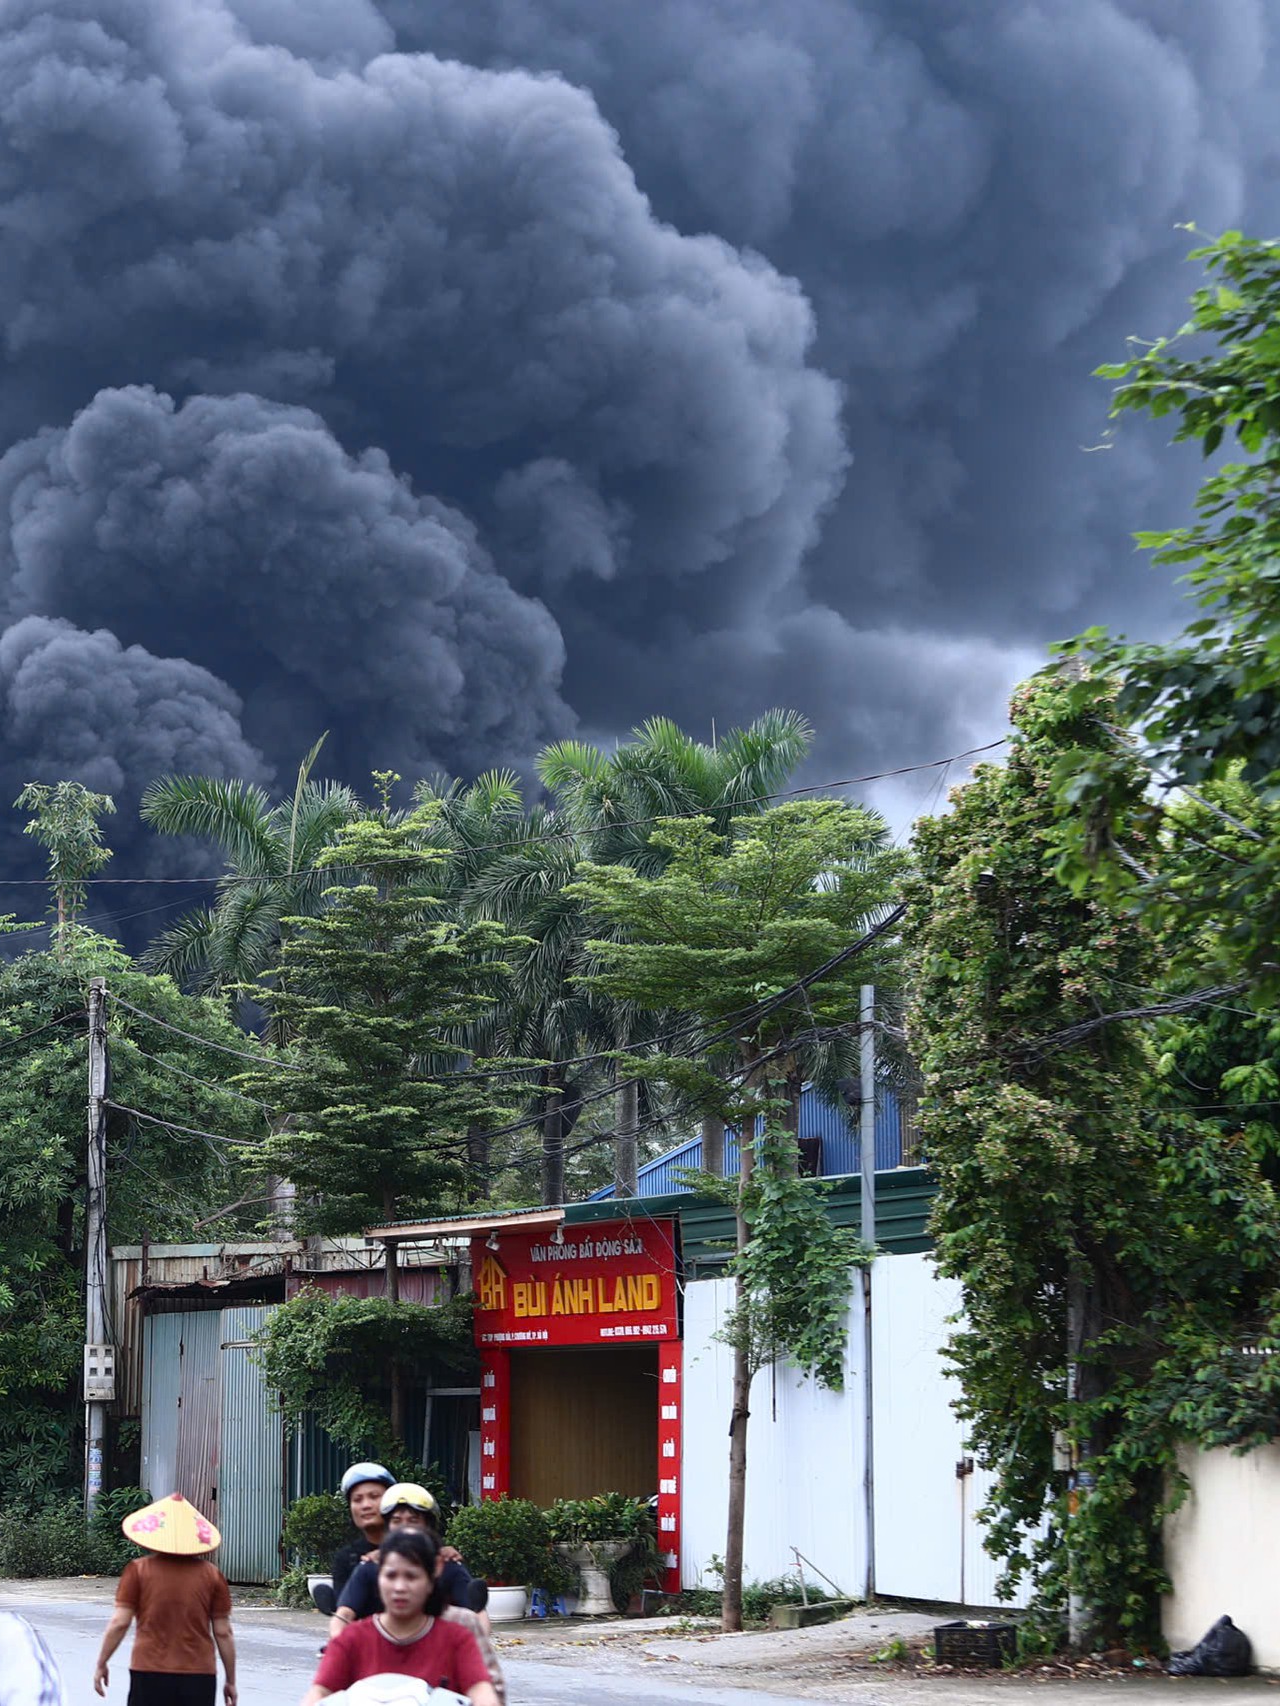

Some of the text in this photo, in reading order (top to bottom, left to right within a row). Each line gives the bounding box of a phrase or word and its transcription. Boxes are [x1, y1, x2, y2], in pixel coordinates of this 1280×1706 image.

[513, 1272, 661, 1318] BÙI ÁNH LAND
